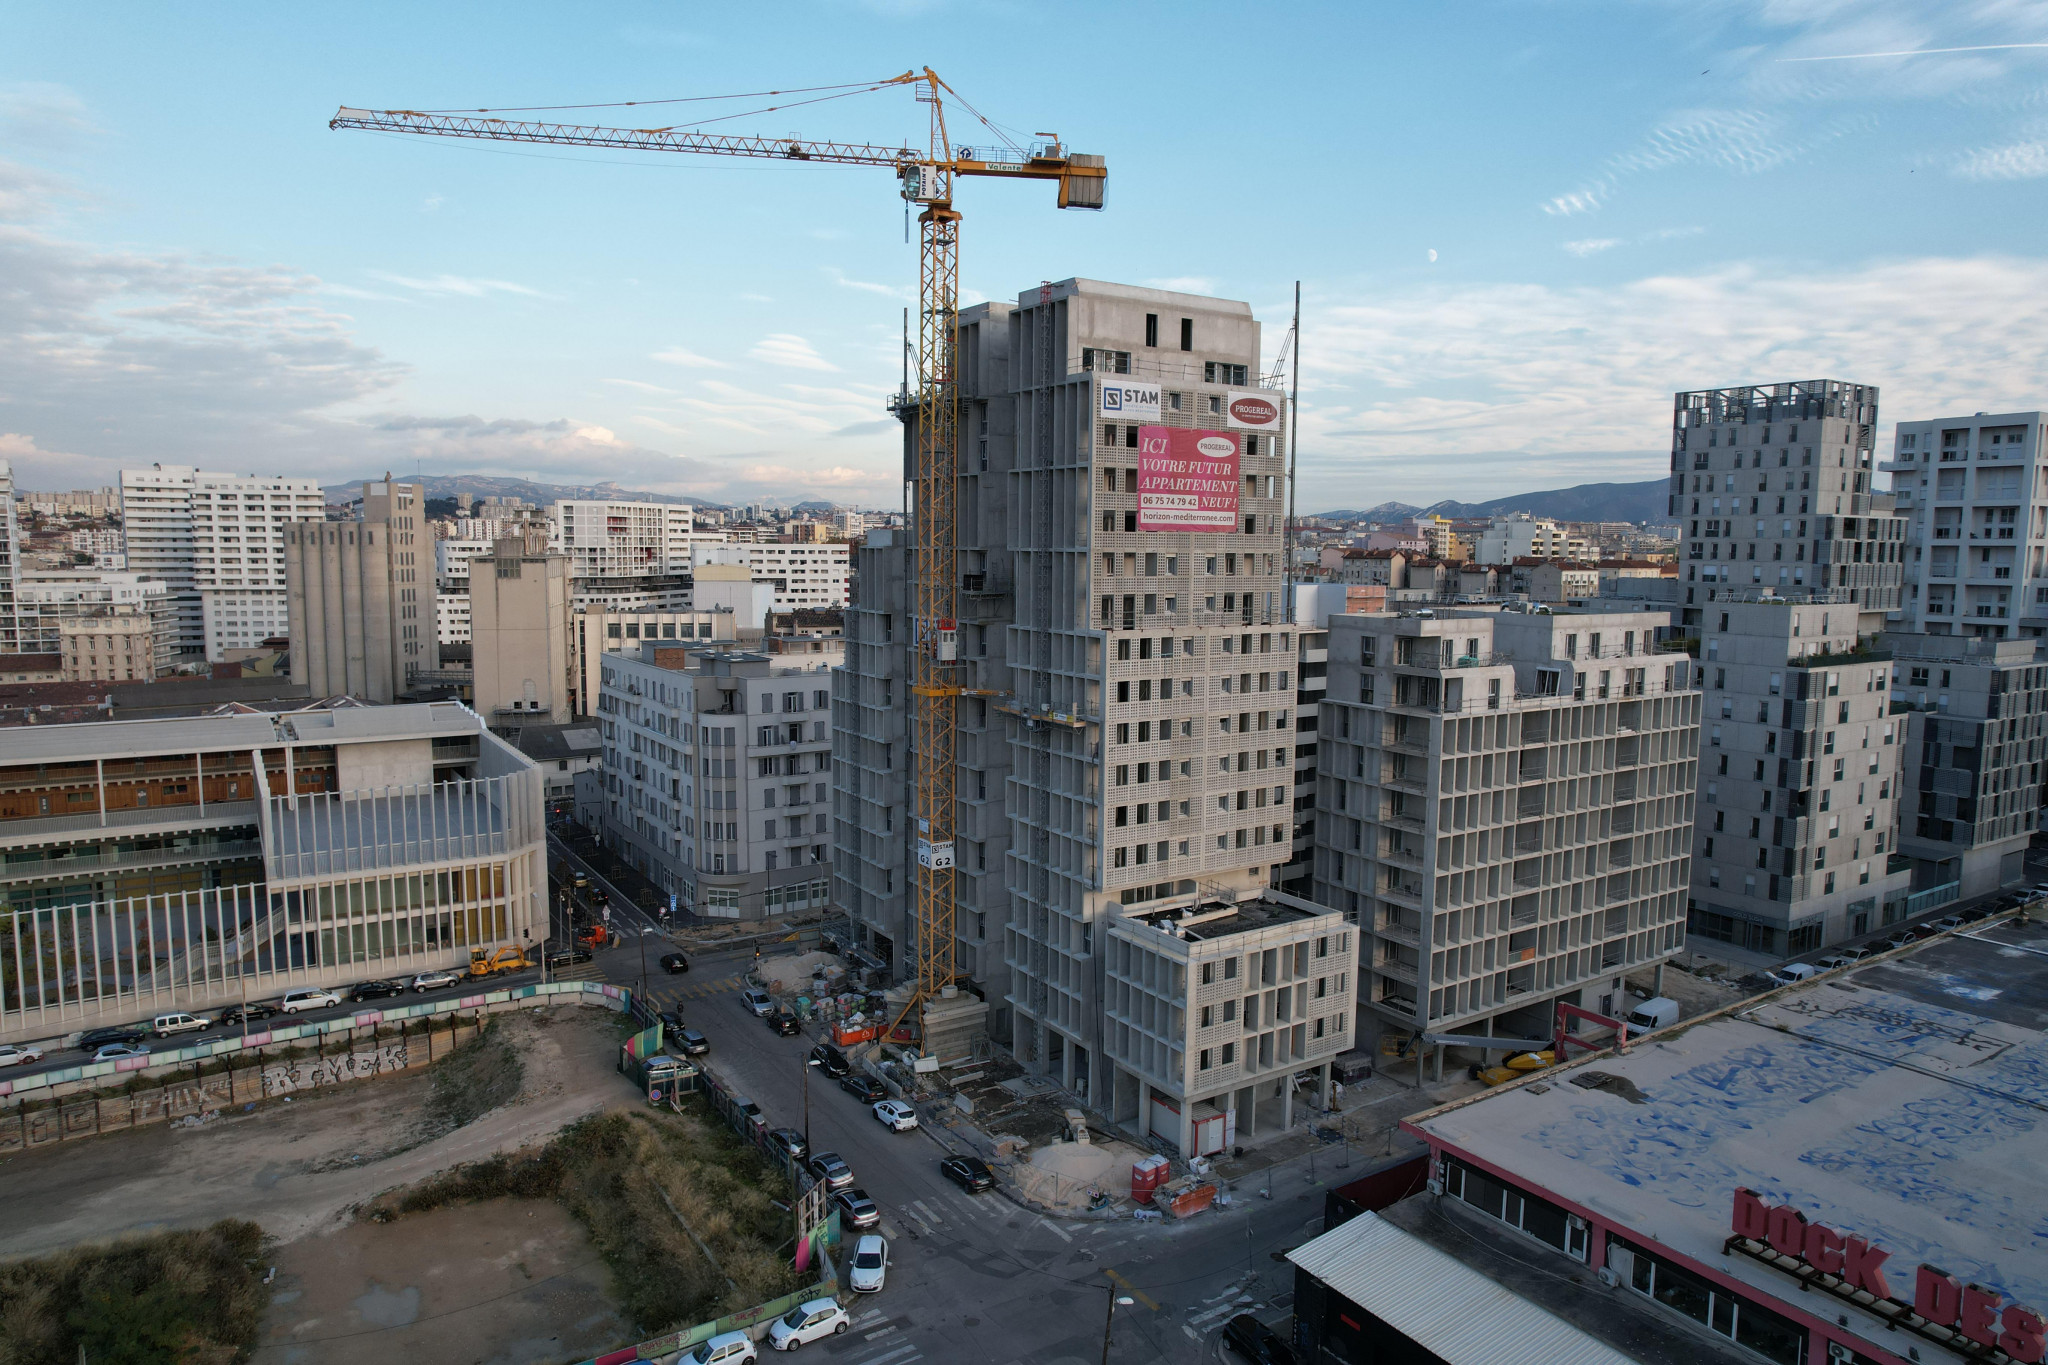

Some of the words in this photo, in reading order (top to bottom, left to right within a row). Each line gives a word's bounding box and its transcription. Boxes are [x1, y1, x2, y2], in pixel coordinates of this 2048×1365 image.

[988, 163, 1021, 171] Valente
[1124, 389, 1158, 404] STAM
[1235, 405, 1272, 415] PROGEREAL
[1141, 437, 1168, 454] ICI
[1200, 443, 1232, 451] PROGEREAL
[1142, 458, 1187, 473] VOTRE
[1188, 461, 1232, 475] FUTUR
[1140, 476, 1237, 492] APPARTEMENT
[1142, 496, 1153, 504] 06
[1155, 497, 1164, 505] 75
[1166, 497, 1175, 505] 74
[1177, 497, 1186, 505] 79
[1187, 498, 1197, 506] 42
[1143, 512, 1233, 522] horizon-mediterranee.com
[1731, 1186, 1894, 1300] DOCK
[1914, 1262, 2048, 1364] DES
